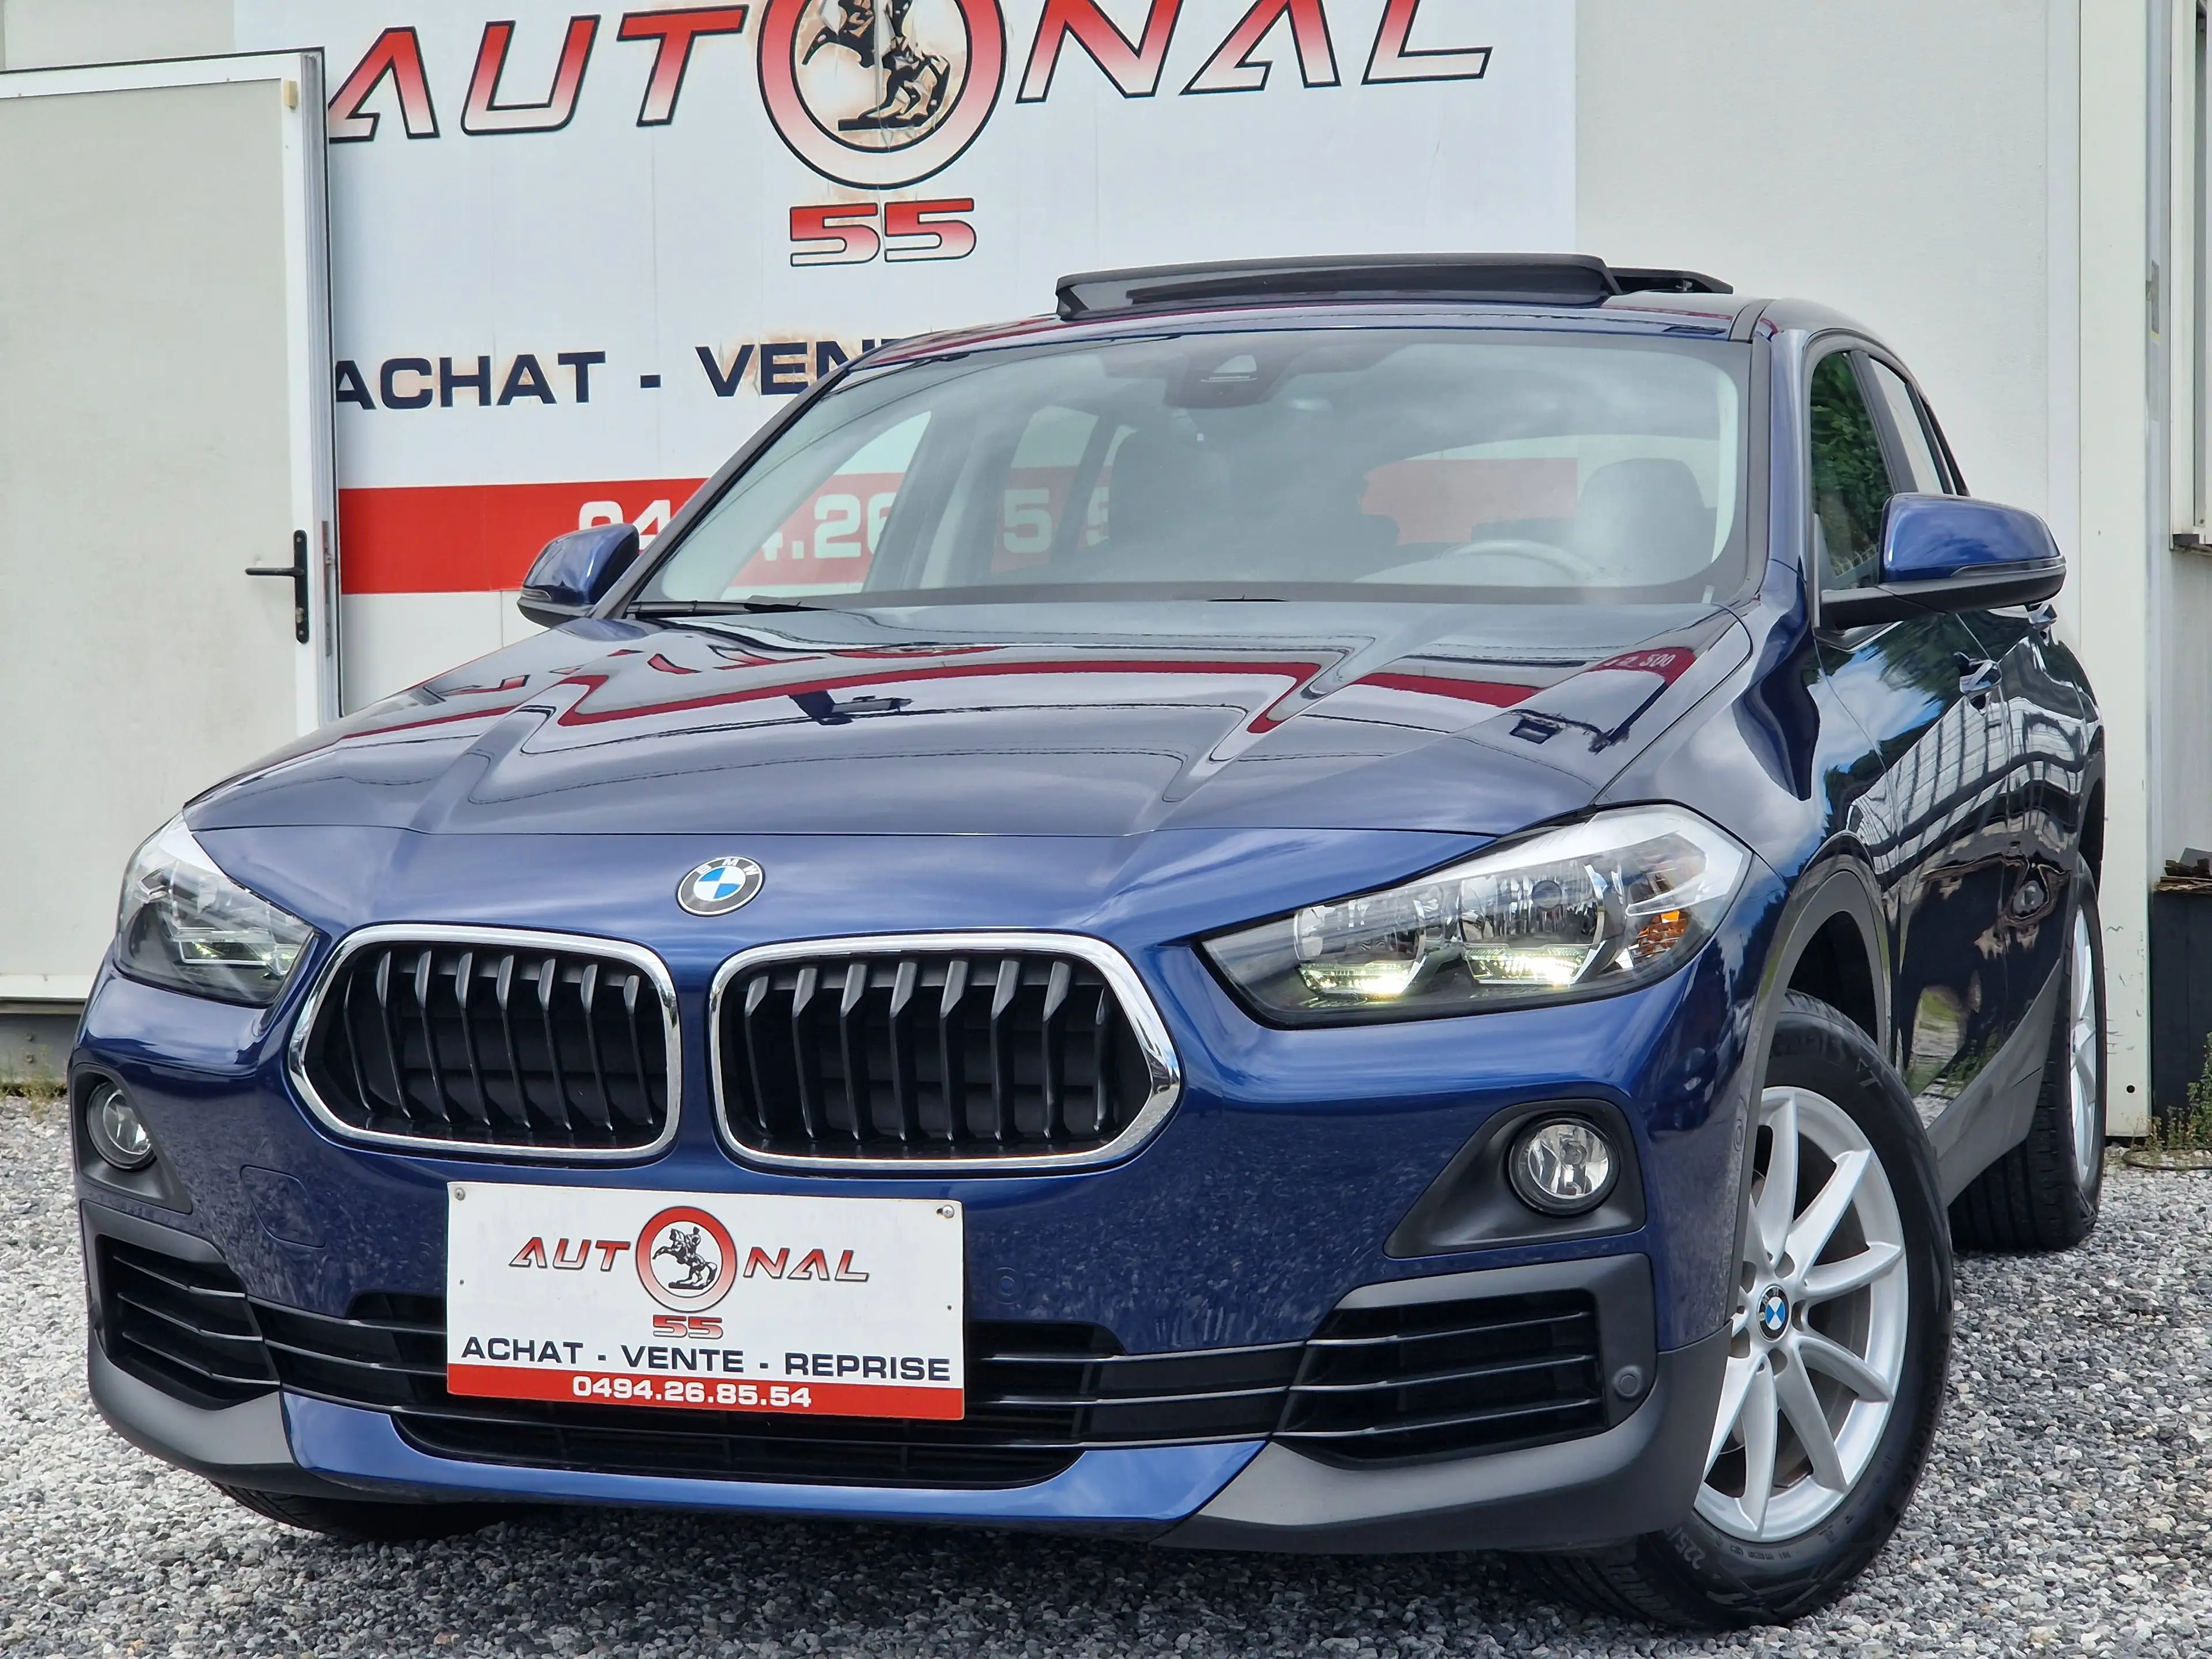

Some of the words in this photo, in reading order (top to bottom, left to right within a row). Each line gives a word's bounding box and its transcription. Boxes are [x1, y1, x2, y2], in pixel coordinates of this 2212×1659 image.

[790, 198, 977, 267] 55
[335, 351, 605, 410] ACHAT
[695, 338, 900, 397] VEN
[652, 1315, 724, 1340] 55
[461, 1336, 584, 1365] ACHAT
[620, 1344, 744, 1373] VENTE
[785, 1352, 950, 1382] REPRISE
[573, 1376, 812, 1407] 0494.26.85.54
